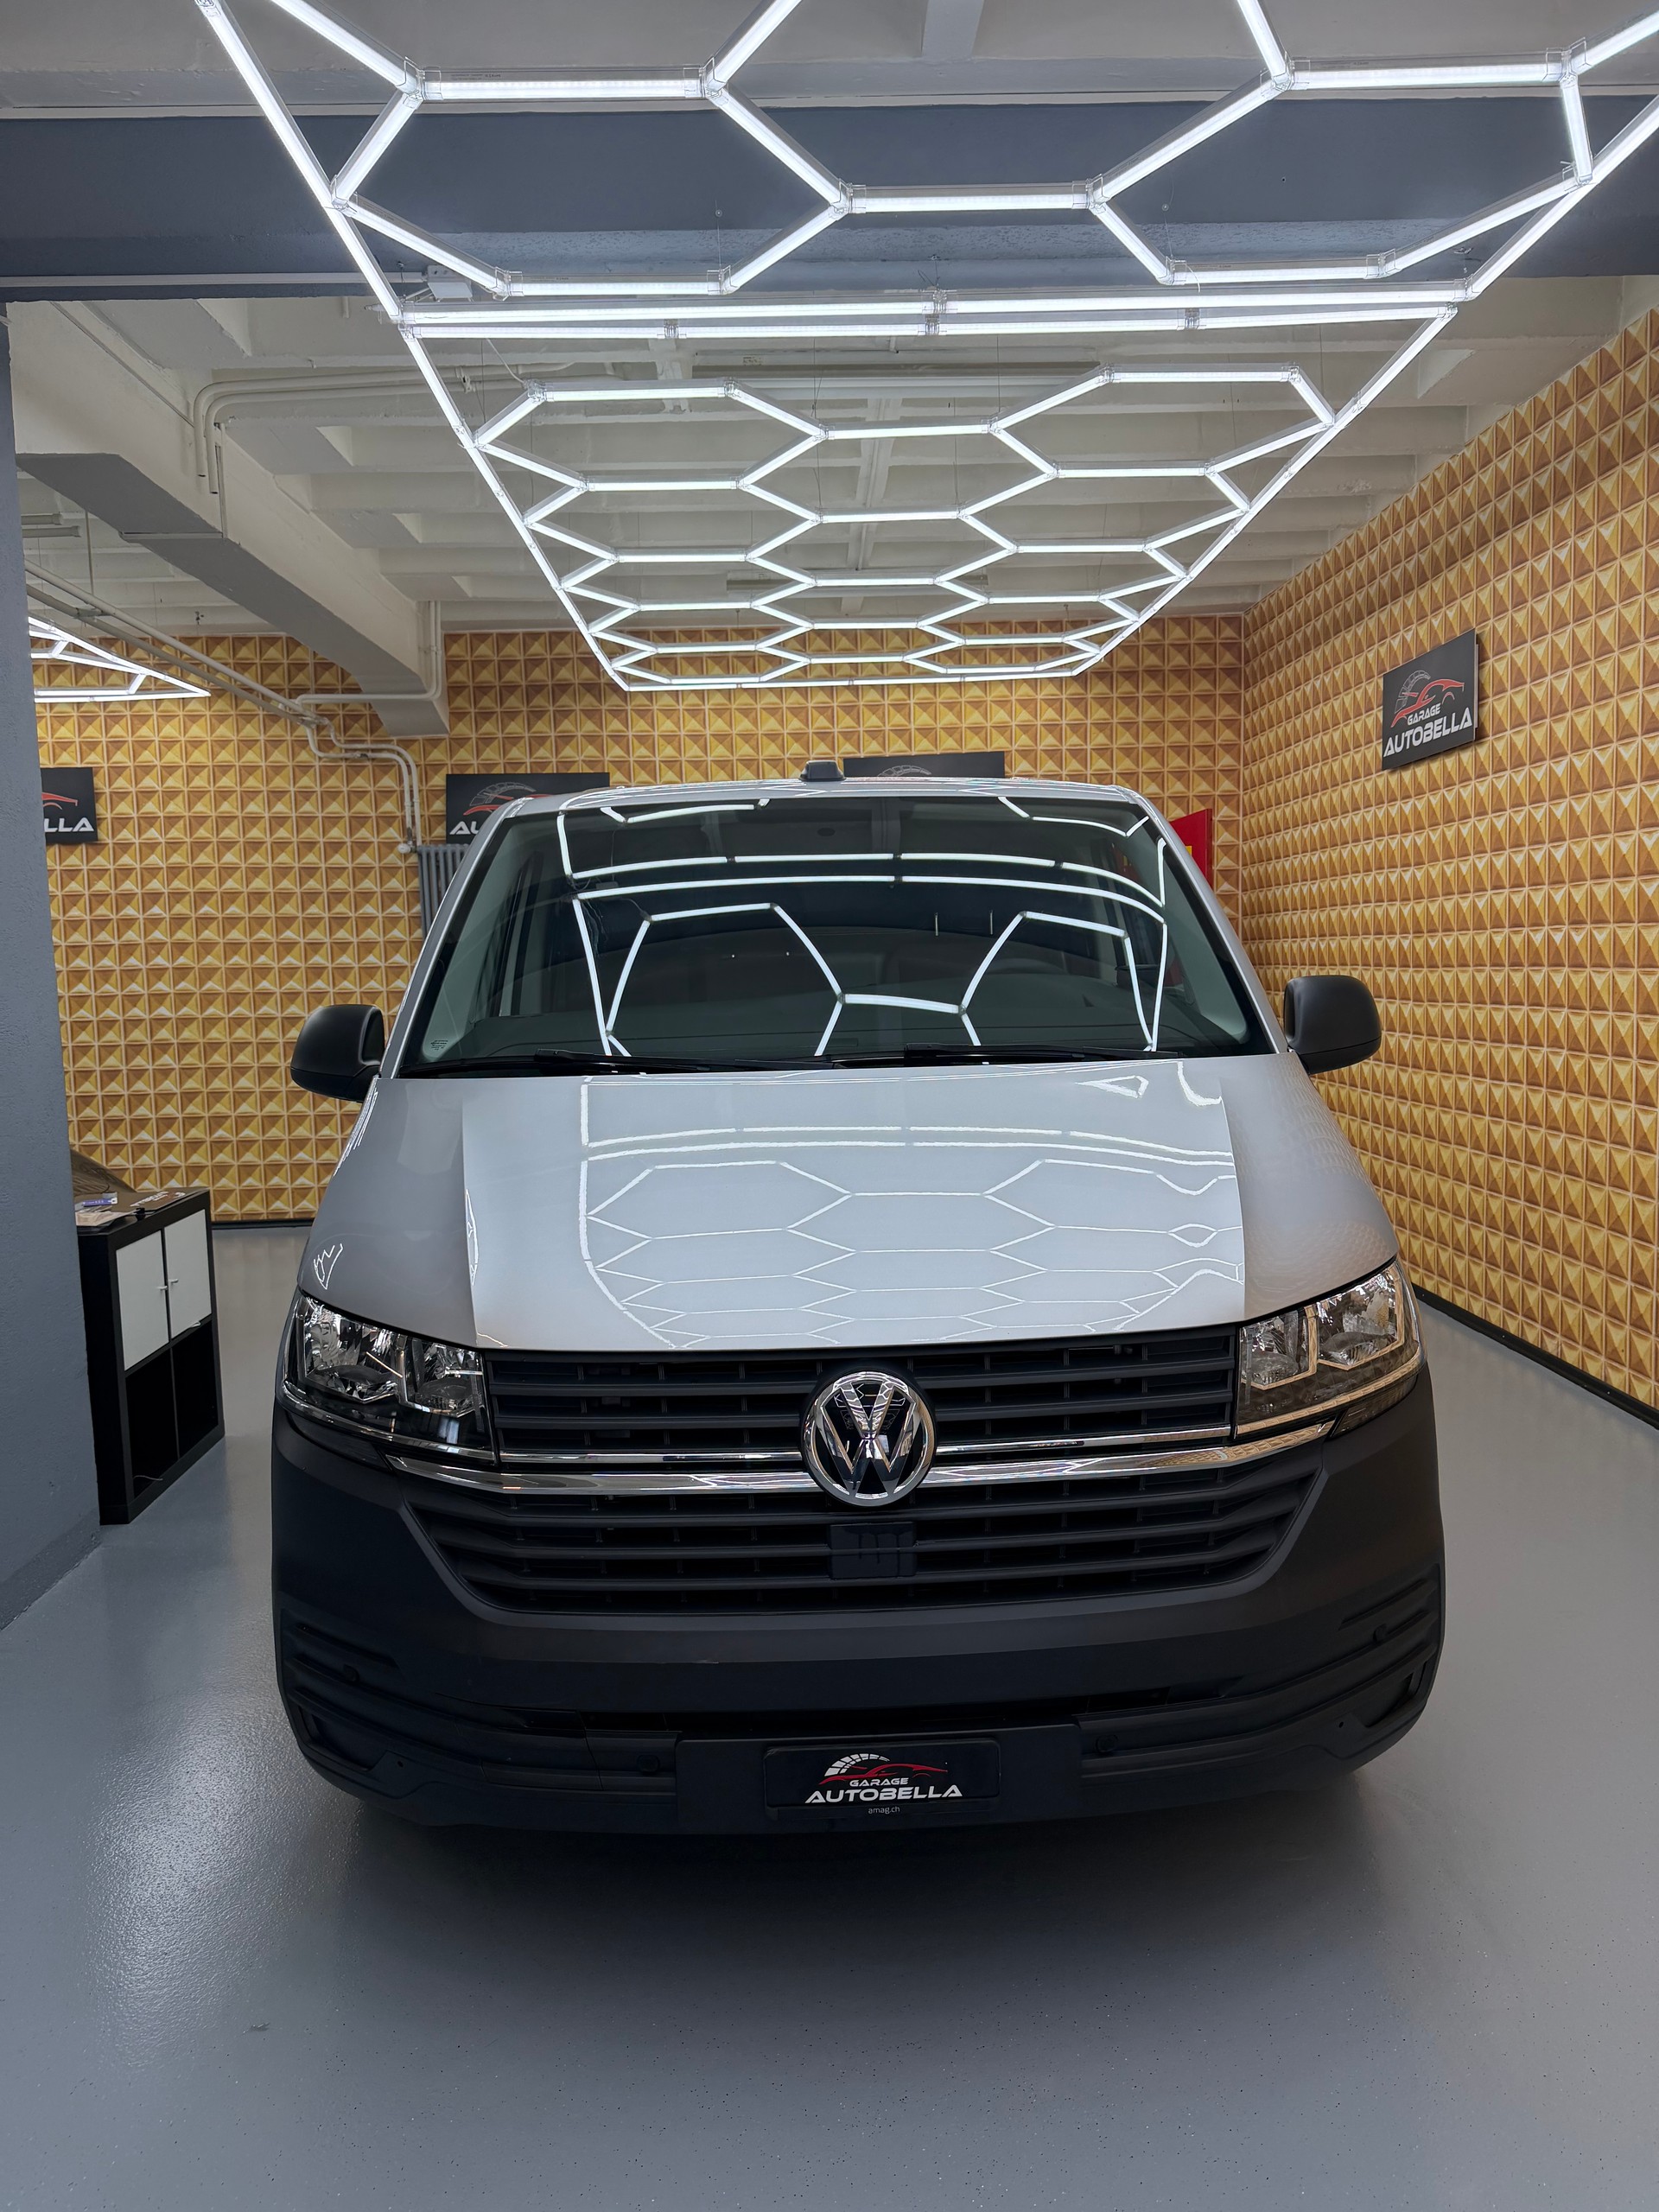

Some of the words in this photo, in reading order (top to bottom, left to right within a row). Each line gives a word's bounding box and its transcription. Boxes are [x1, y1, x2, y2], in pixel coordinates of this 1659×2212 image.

[1407, 702, 1441, 726] GARAGE
[1382, 707, 1473, 758] AUTOBELLA
[810, 1379, 925, 1498] VW
[849, 1777, 909, 1788] GARAGE
[804, 1784, 963, 1804] AUTOBELLA
[868, 1806, 900, 1815] amag.ch
